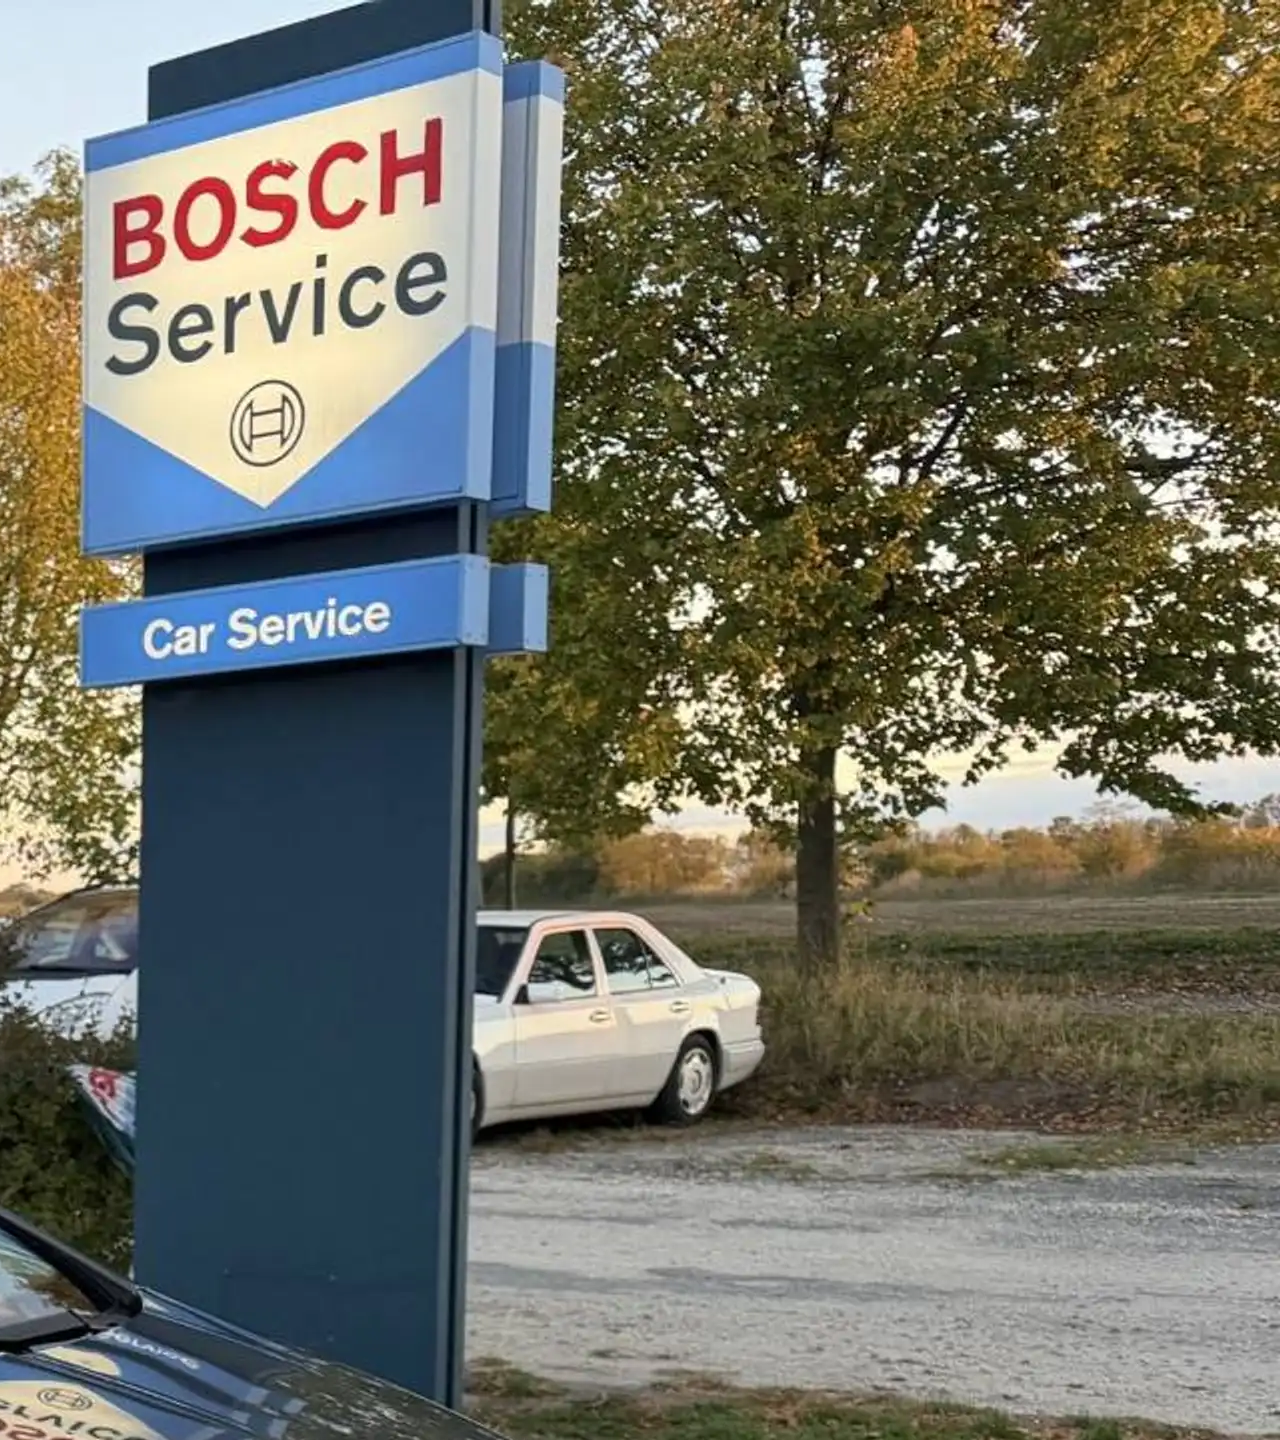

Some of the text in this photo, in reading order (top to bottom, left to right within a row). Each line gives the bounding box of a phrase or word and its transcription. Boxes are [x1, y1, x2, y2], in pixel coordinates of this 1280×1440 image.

[111, 117, 444, 281] BOSCH
[104, 250, 449, 377] Service
[142, 598, 391, 661] Car Service
